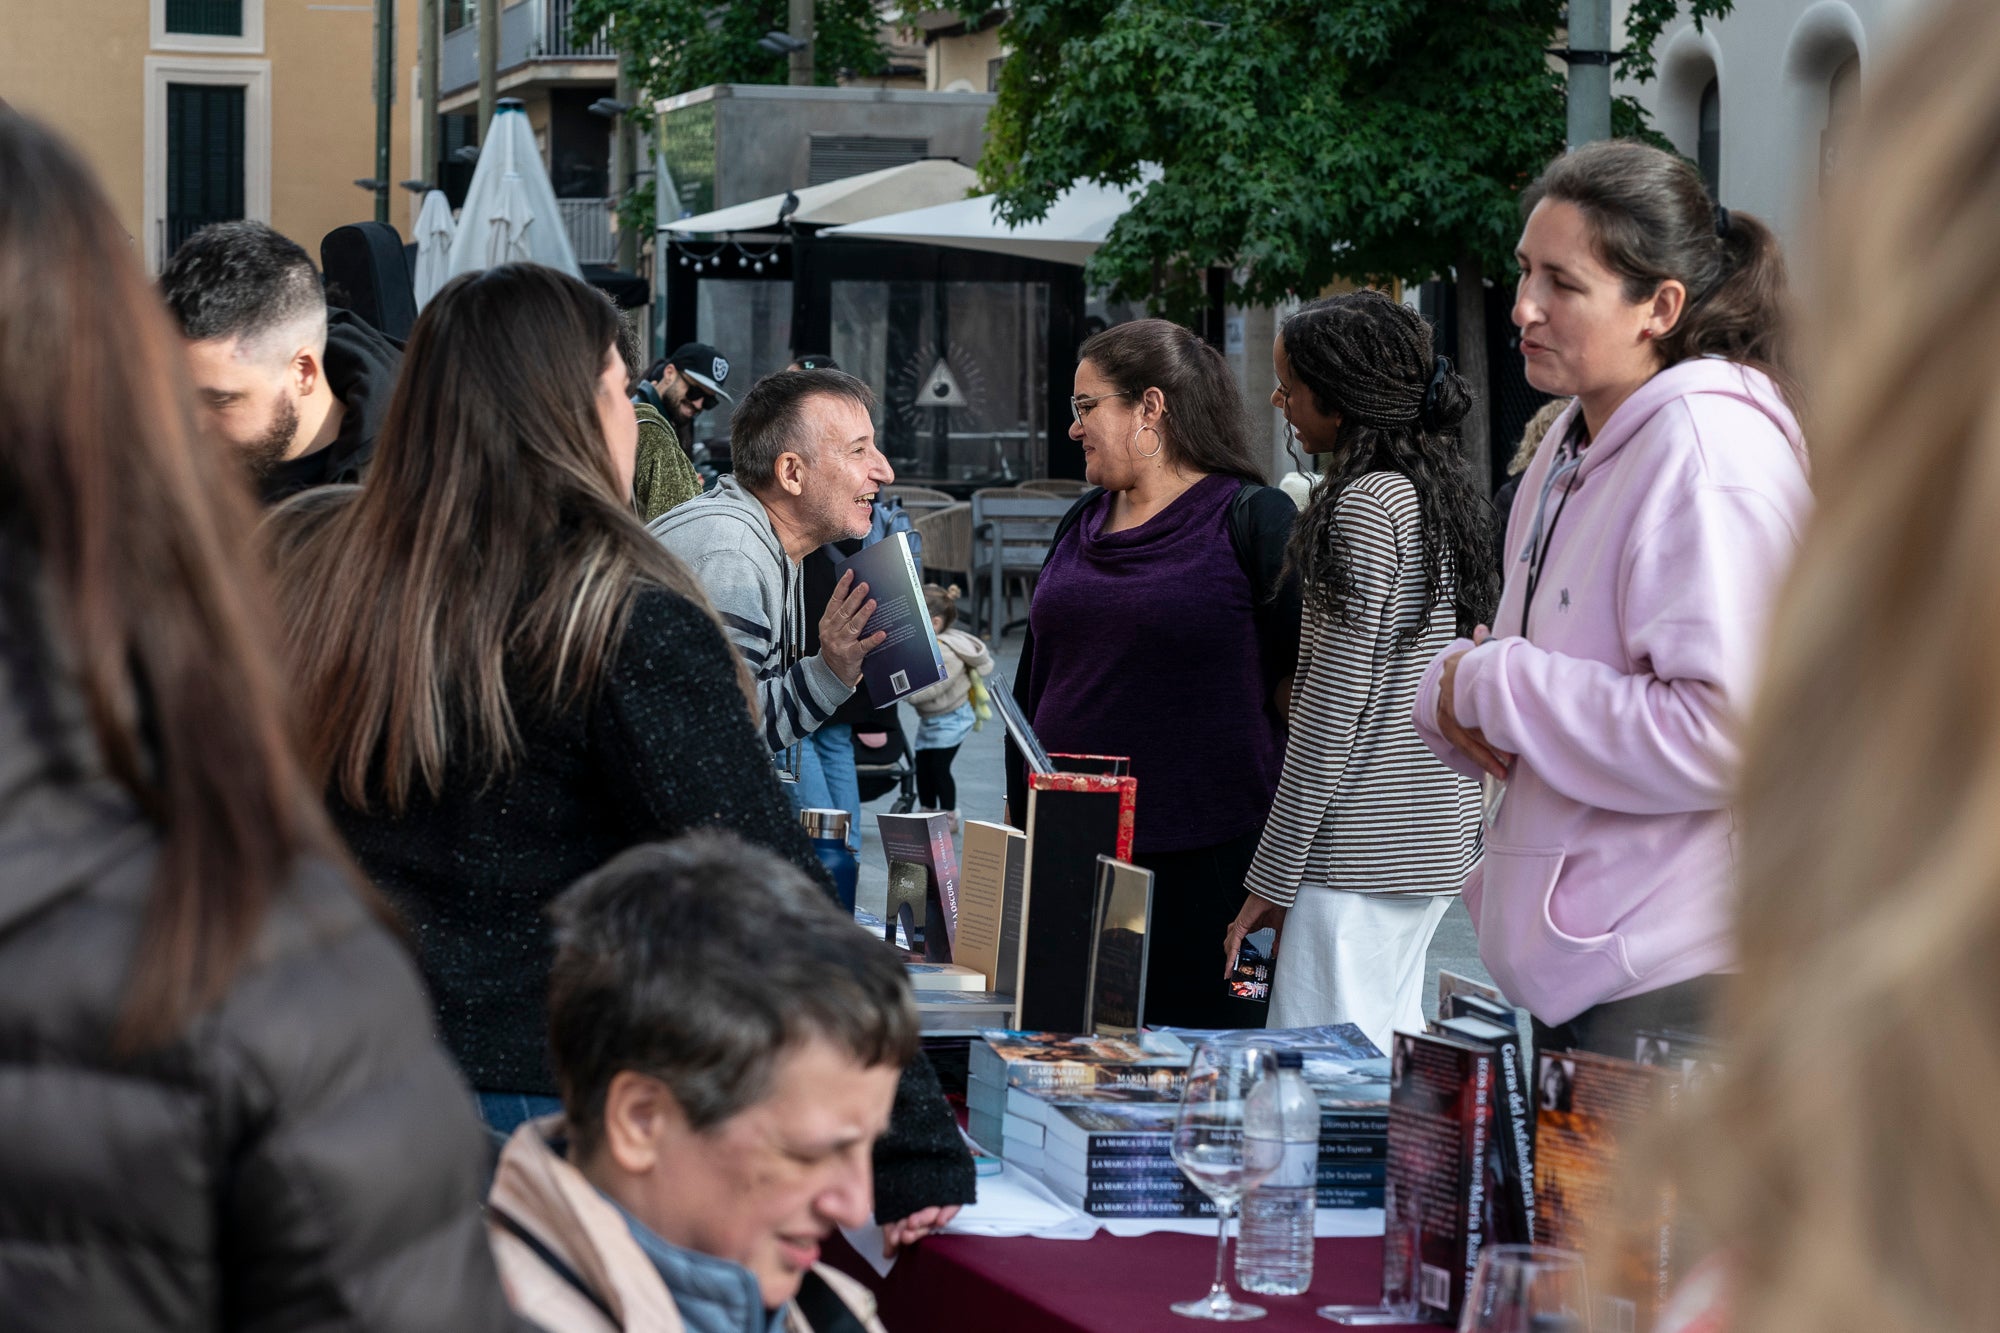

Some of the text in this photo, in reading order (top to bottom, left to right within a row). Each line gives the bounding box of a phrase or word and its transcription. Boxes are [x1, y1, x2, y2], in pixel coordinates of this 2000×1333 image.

[945, 880, 958, 912] OSCURA
[1476, 1057, 1489, 1089] ECOS
[1475, 1090, 1488, 1105] DE
[1501, 1043, 1532, 1167] Garras del Asfalto
[1467, 1184, 1484, 1230] María
